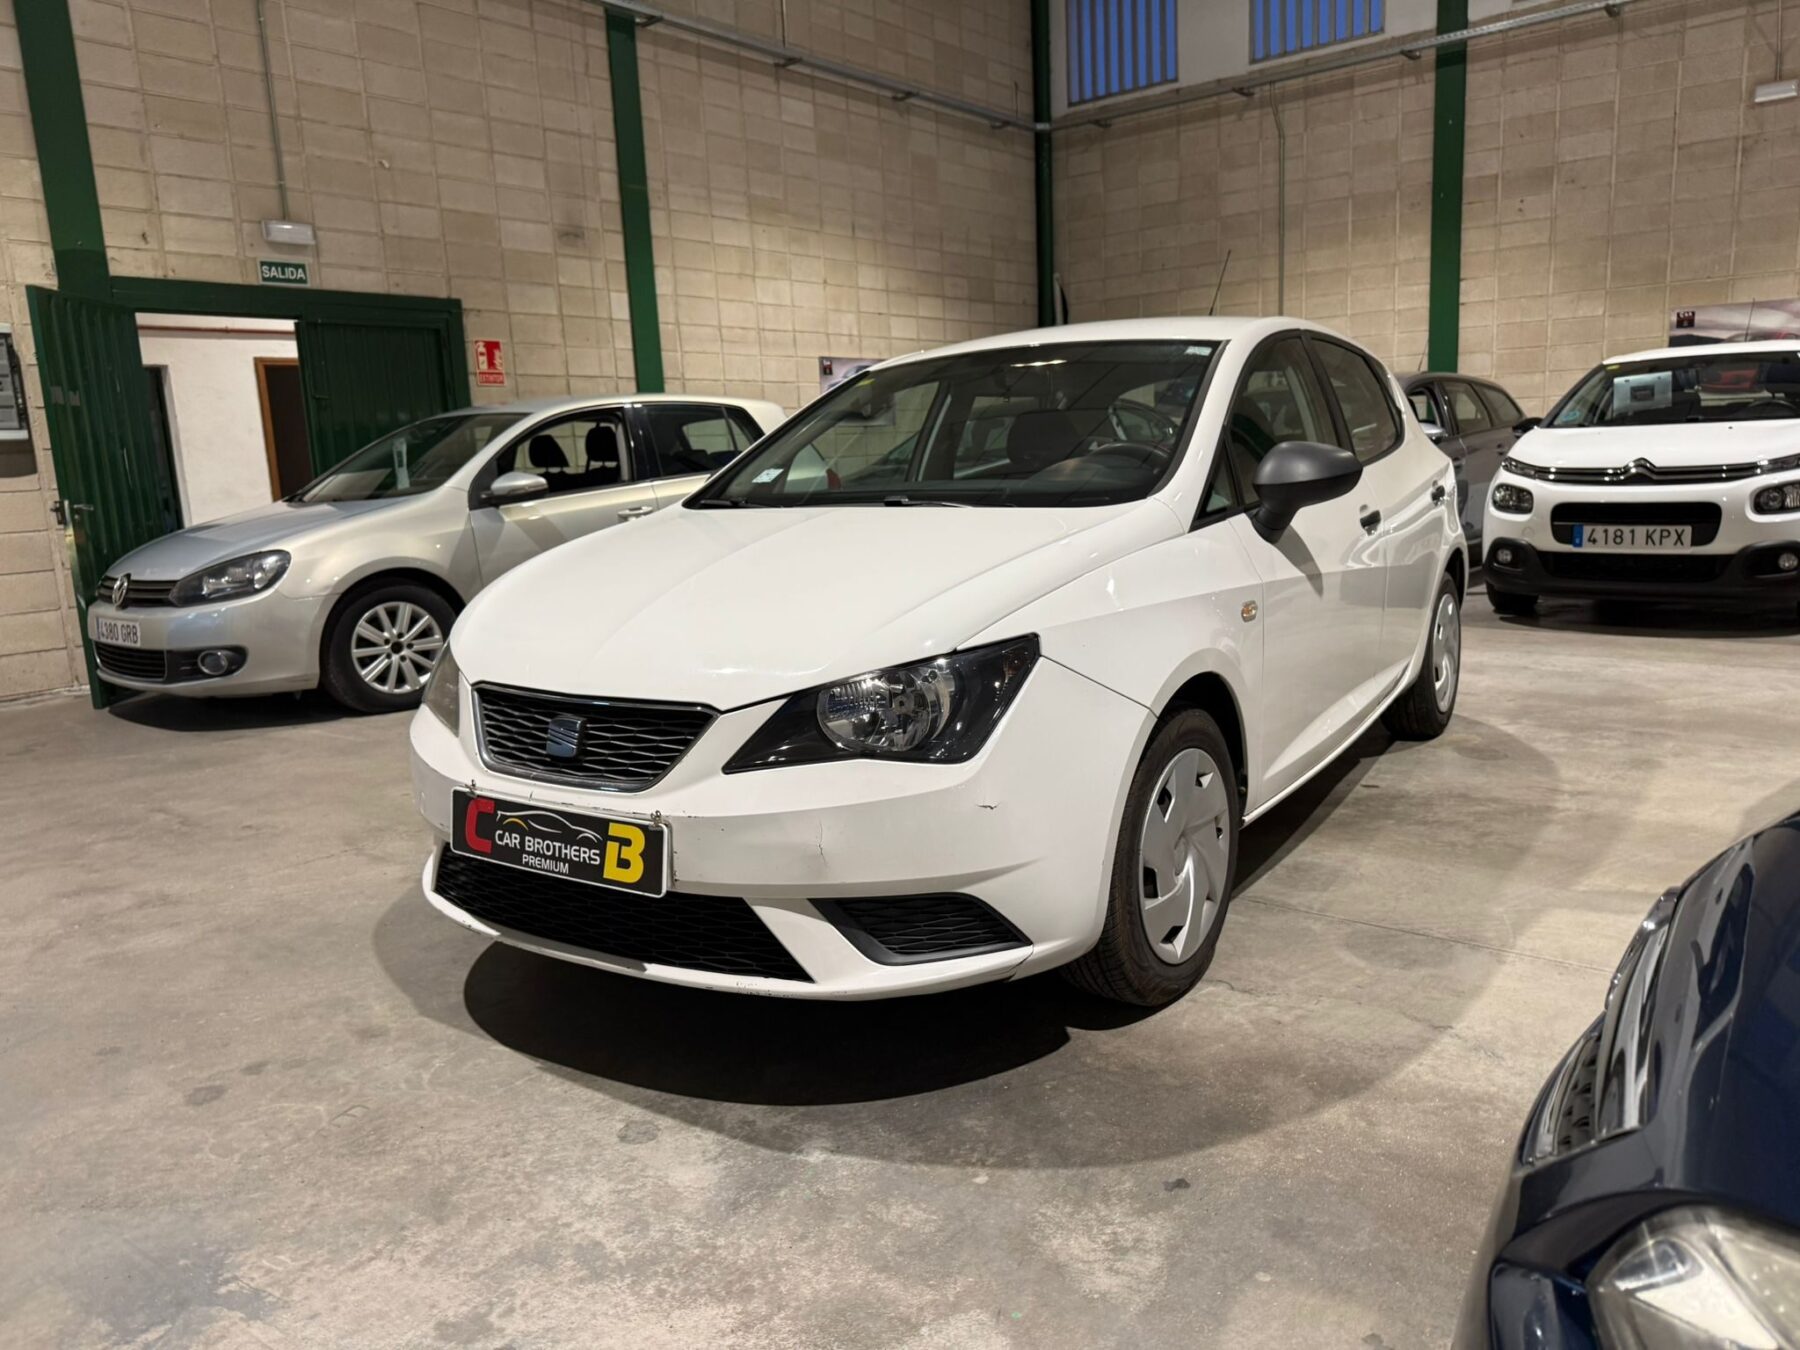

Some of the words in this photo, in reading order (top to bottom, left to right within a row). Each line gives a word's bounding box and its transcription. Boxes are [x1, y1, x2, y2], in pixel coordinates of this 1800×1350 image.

[262, 265, 306, 280] SALIDA
[1587, 528, 1635, 546] 4181
[1645, 528, 1685, 547] KPX
[120, 623, 139, 644] GRB
[495, 829, 521, 849] CAR
[525, 836, 601, 865] BROTHERS
[522, 853, 570, 875] PREMIUM
